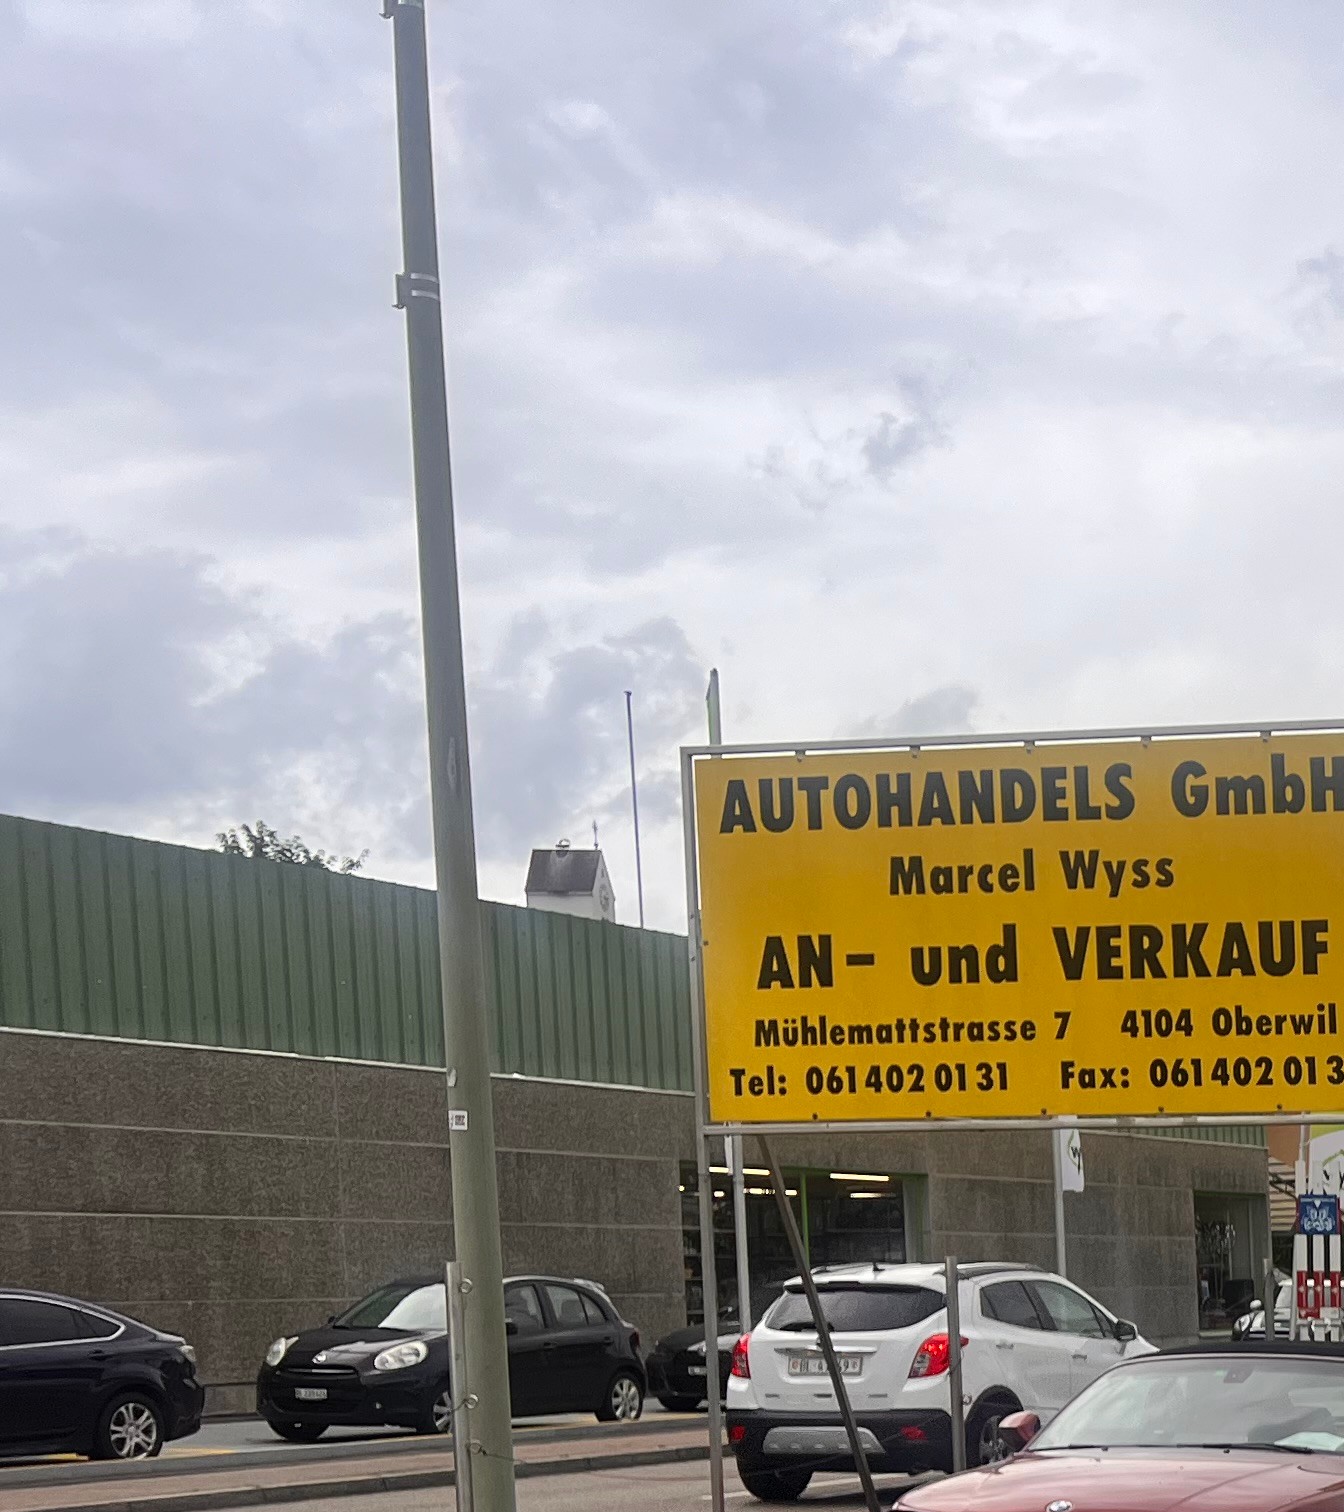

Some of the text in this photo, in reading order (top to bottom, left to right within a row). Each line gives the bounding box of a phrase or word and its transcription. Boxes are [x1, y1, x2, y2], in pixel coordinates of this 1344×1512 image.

[719, 762, 1135, 834] AUTOHANDELS
[890, 848, 1174, 898] Marcel Wyss
[910, 923, 1019, 986] und
[1052, 919, 1329, 981] VERKAUF
[754, 1003, 1337, 1047] Mühlemattstrasse 7 4104 Oberwil
[730, 1065, 787, 1096] Tel:
[1060, 1060, 1131, 1089] Fax:
